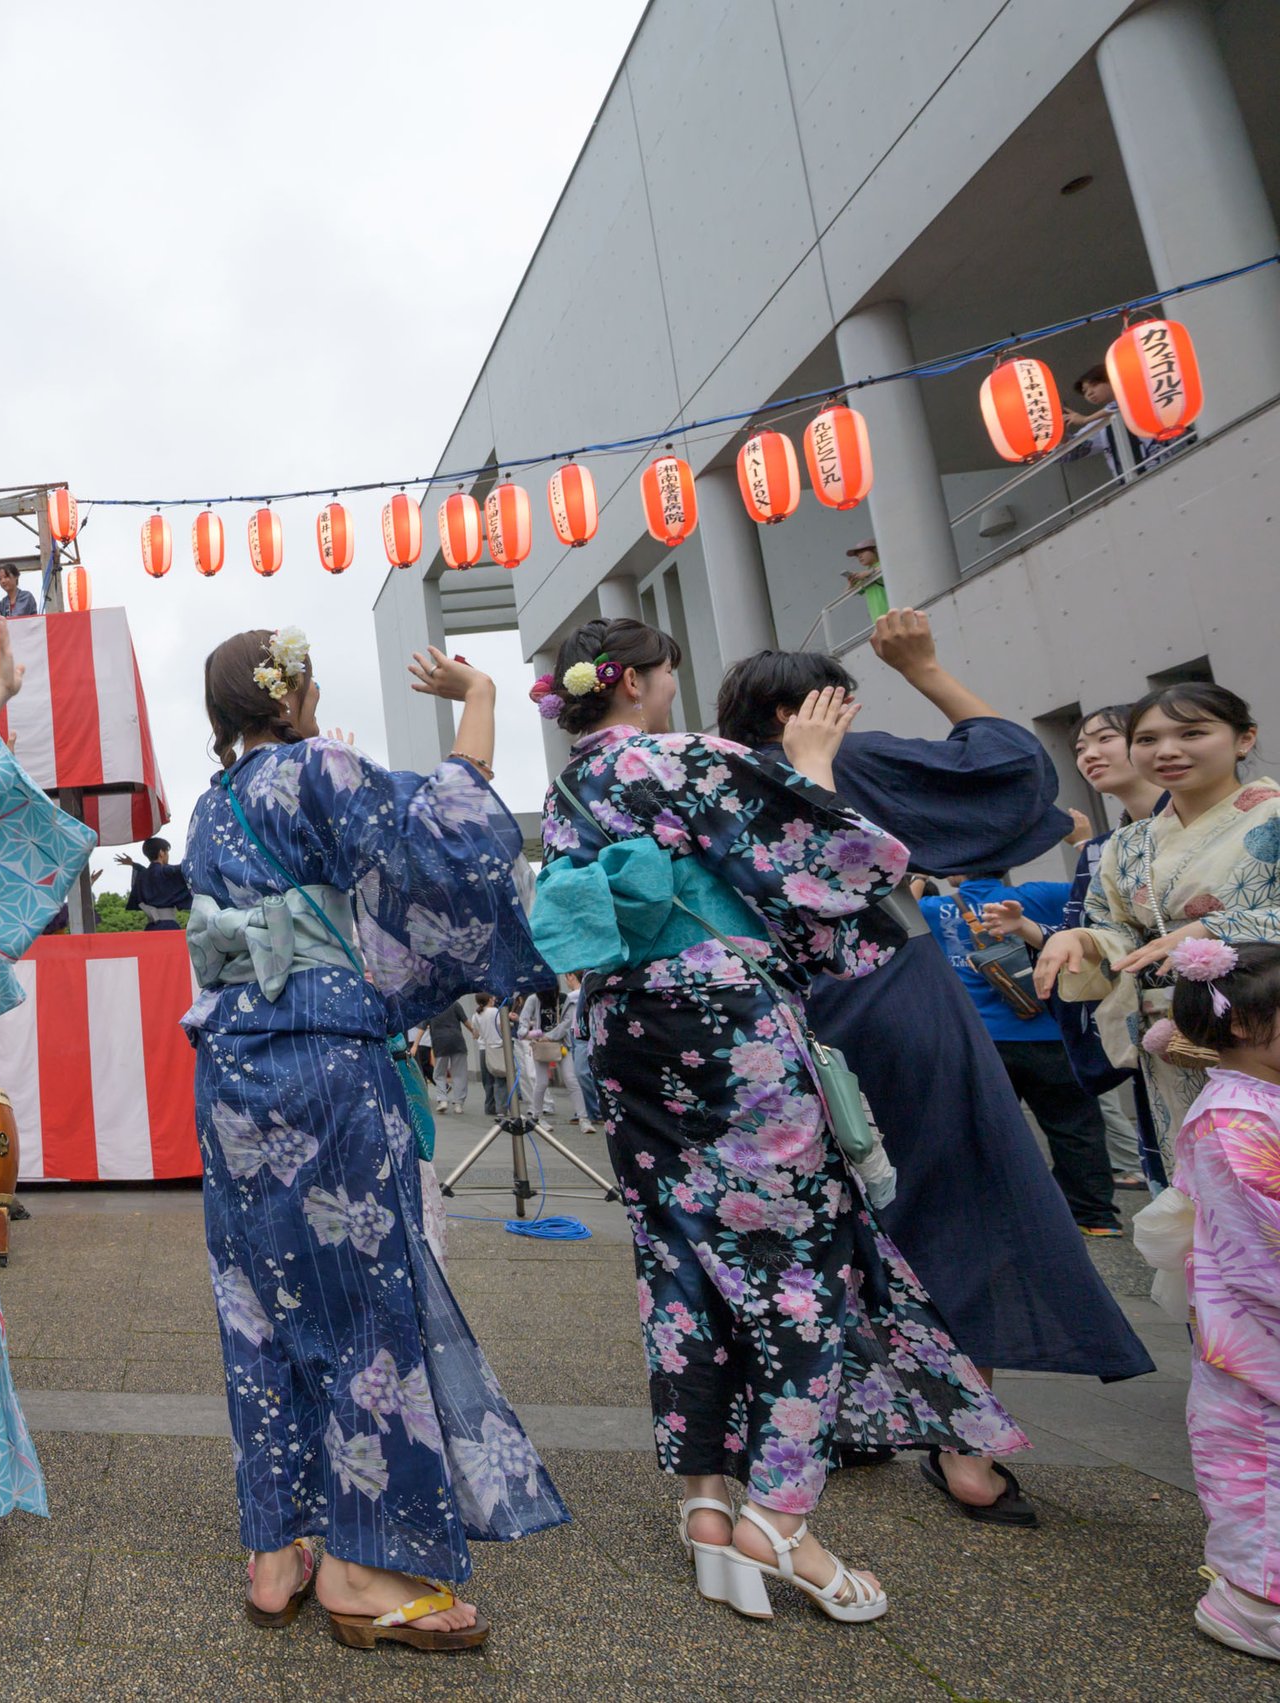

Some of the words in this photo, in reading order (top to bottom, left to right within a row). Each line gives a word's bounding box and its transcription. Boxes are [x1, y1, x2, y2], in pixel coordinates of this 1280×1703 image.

[1140, 328, 1183, 409] カフェコルテ
